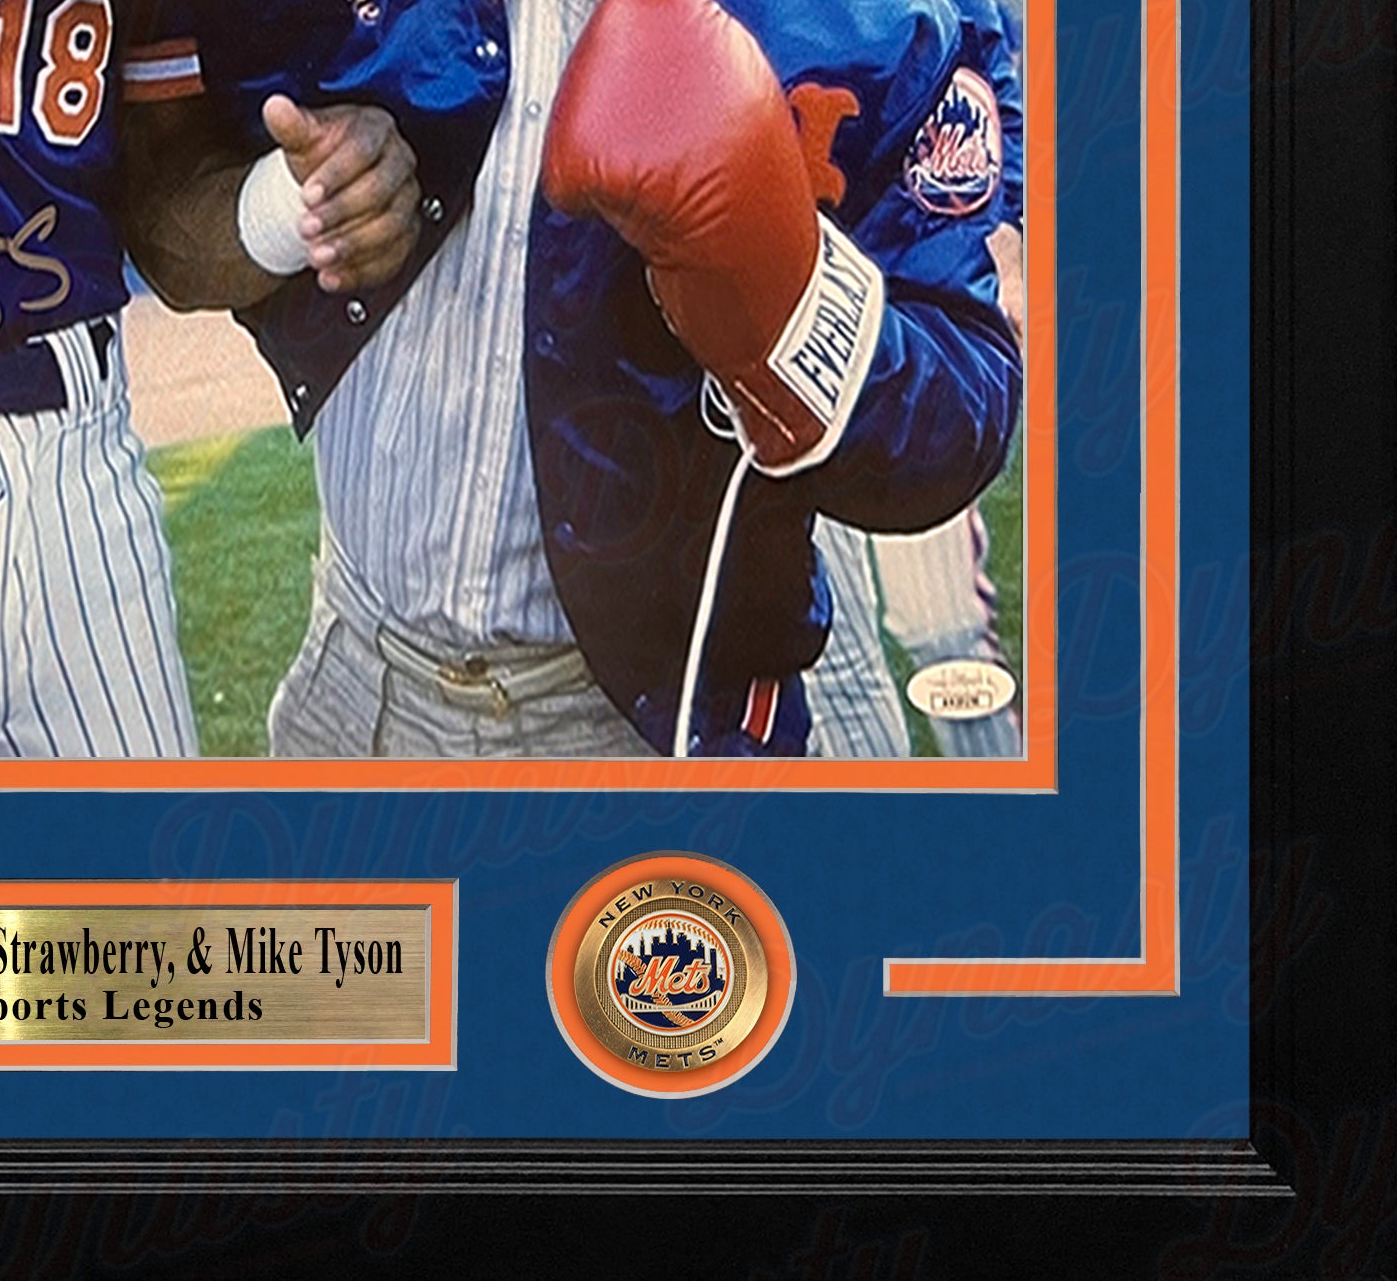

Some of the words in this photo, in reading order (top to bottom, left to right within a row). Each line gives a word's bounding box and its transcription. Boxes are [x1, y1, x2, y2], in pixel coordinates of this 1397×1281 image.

[789, 230, 871, 409] EVERLAST
[598, 884, 653, 928] NEW
[670, 881, 743, 926] YORK
[186, 926, 213, 975] &
[224, 926, 303, 975] Mike
[315, 927, 403, 988] Tyson
[628, 956, 712, 997] Mets
[102, 989, 264, 1029] Legends
